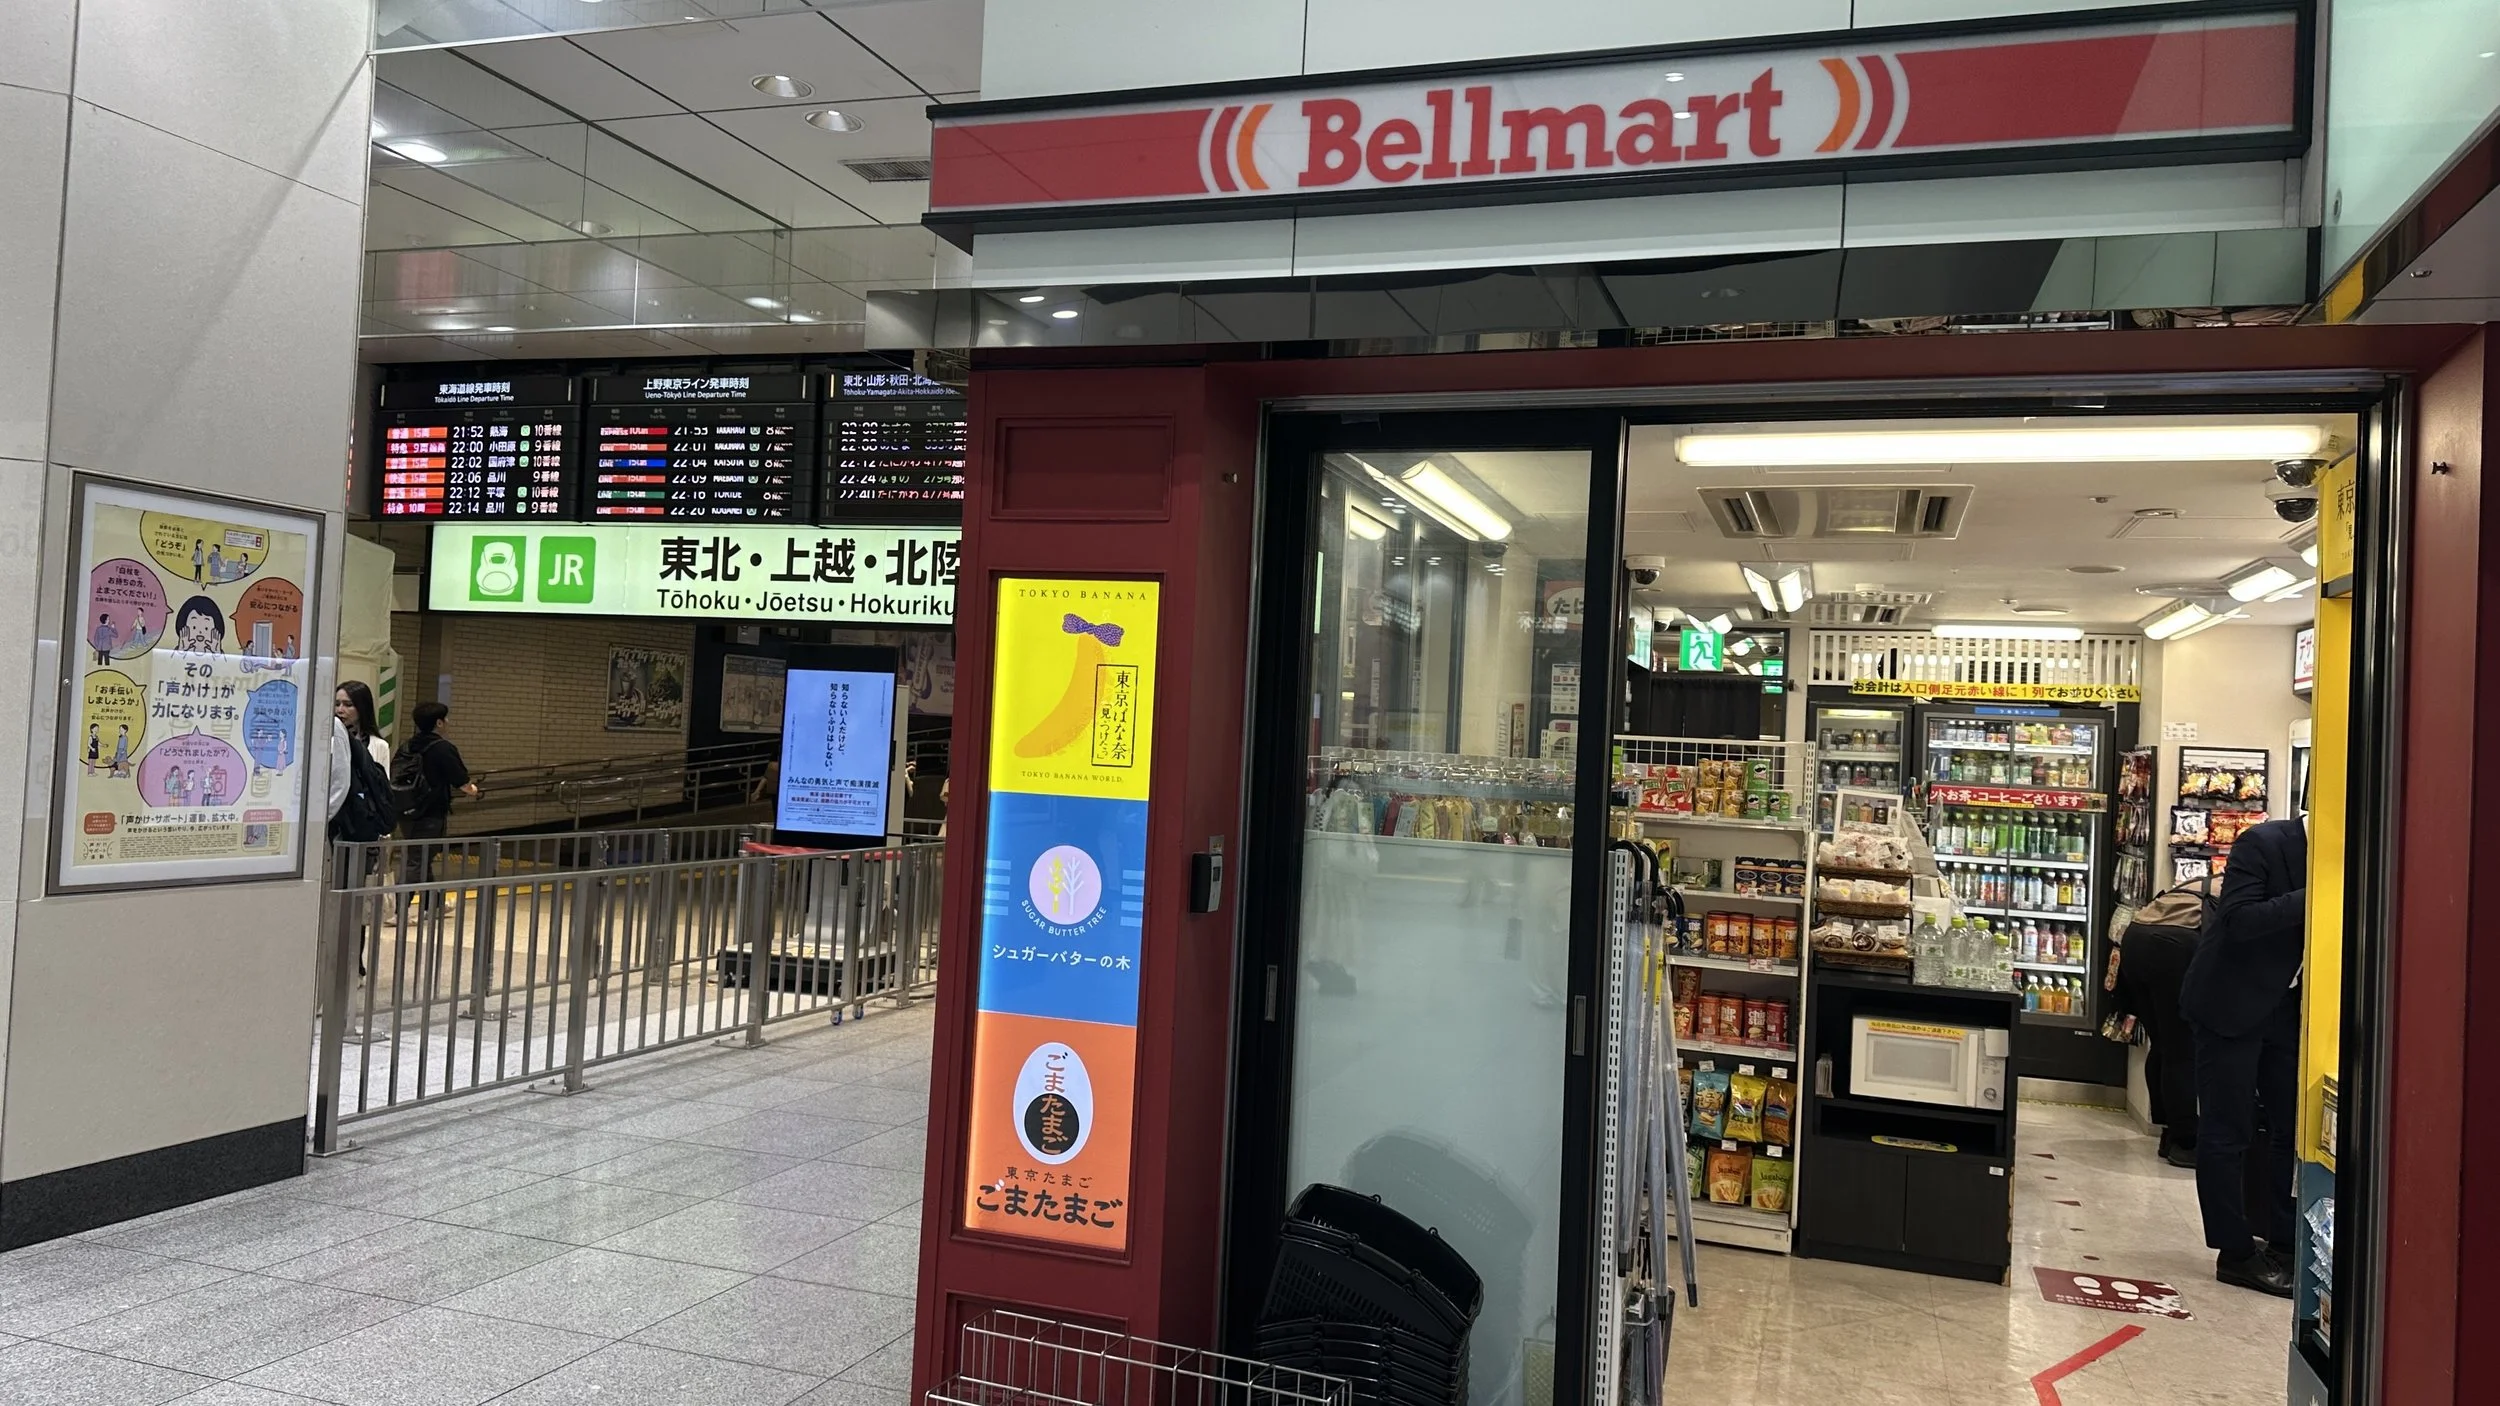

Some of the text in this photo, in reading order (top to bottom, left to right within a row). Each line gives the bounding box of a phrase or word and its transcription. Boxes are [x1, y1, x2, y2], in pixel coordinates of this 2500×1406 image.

[1298, 66, 1783, 187] Bellmart
[439, 382, 511, 394] 東海道線発車時刻
[643, 377, 750, 390] 上野東京ライン発車時刻
[470, 395, 499, 404] Departure
[698, 391, 730, 399] Departure
[453, 426, 484, 438] 21:52
[490, 426, 508, 438] 熱海
[535, 425, 562, 436] 10番線
[452, 441, 484, 453] 22:00
[488, 441, 516, 452] 小田原
[534, 440, 561, 452] 9番線
[451, 456, 482, 468] 22:02
[488, 456, 516, 468] 国府津
[533, 456, 560, 468] 10番線
[450, 472, 482, 484] 22:06
[487, 472, 506, 483] 品川
[533, 471, 560, 482] 9番線
[450, 487, 480, 499] 22:12
[486, 487, 506, 498] 平塚
[532, 486, 558, 498] 10番線
[448, 502, 480, 514] 22:14
[486, 502, 504, 514] 品川
[532, 501, 558, 513] 9番線
[154, 540, 187, 551] 「どうぞ」
[116, 566, 140, 576] 「白杖を
[547, 552, 584, 588] JR
[108, 577, 146, 588] お持ちの方、
[1019, 589, 1147, 600] TOKYO BANANA
[250, 601, 298, 612] 安心につながる
[2300, 634, 2315, 660] デザ
[184, 662, 213, 678] その
[95, 685, 134, 695] 「お手伝い
[158, 680, 236, 700] 「声かけ」が
[88, 696, 140, 706] しましょうか」
[152, 702, 240, 720] 力になります。
[1111, 670, 1131, 760] 東京ばな奈
[838, 683, 850, 756] 知らない人だけど、
[824, 683, 838, 772] 知らないふりはしない。
[787, 776, 880, 789] みんなの勇気と声で痴漢撲滅
[1022, 771, 1124, 783] TOKYO BANANA WORLD.
[1021, 899, 1108, 937] SUGAR BUTTER TREE
[992, 944, 1131, 971] シュガーバターの木
[1040, 1052, 1068, 1155] ごまたまご
[1005, 1166, 1092, 1189] 東京たまご
[976, 1178, 1124, 1229] ごまたまご
